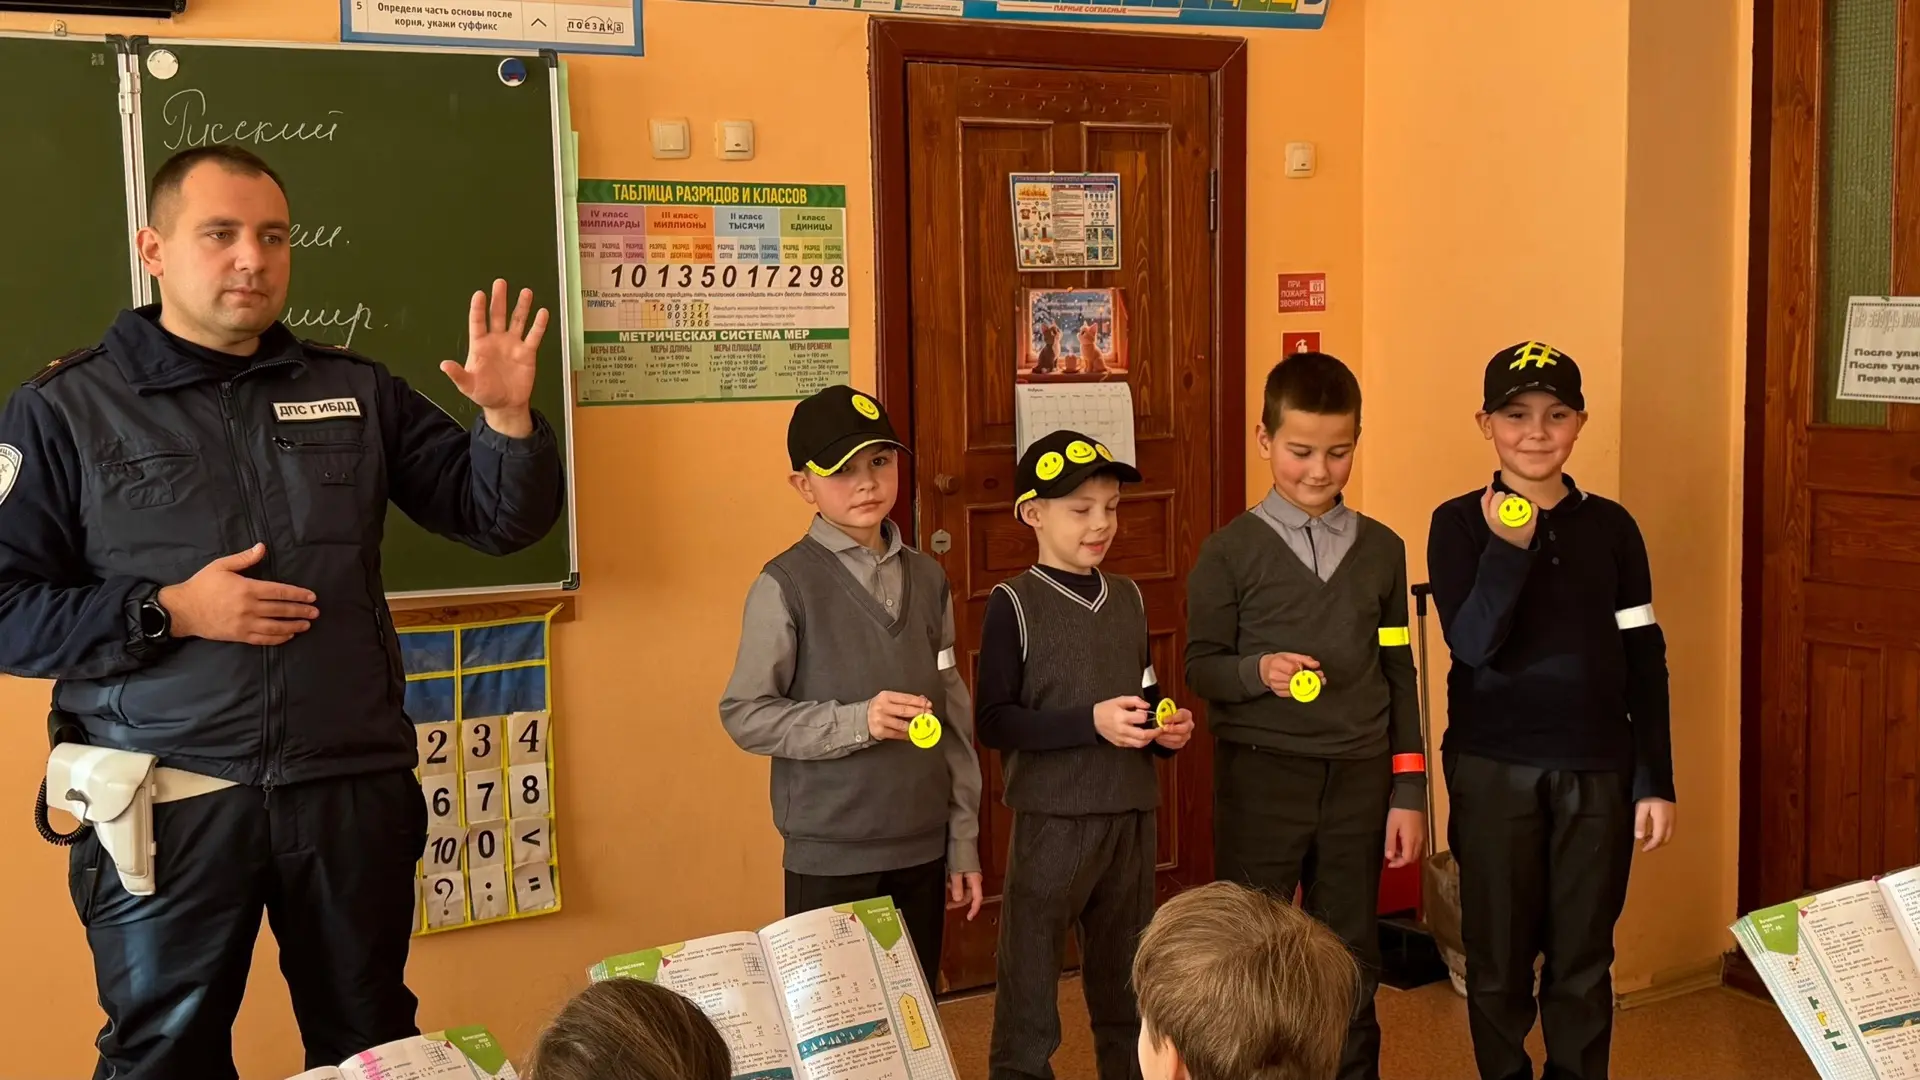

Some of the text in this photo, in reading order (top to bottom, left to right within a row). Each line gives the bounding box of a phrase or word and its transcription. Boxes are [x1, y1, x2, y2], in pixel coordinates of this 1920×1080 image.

[356, 1, 513, 18] 5 Определи часть основы после
[1053, 4, 1084, 12] ПАРНЫЕ
[394, 18, 498, 31] корня, укажи суффикс
[567, 18, 624, 33] поездка
[612, 184, 808, 204] ТАБЛИЦА РАЗРЯДОВ И КЛАССОВ
[590, 210, 600, 218] IV
[580, 220, 640, 229] МИЛЛИАРДЫ
[587, 300, 616, 308] ПРИМЕРЫ:
[619, 330, 810, 341] МЕТРИЧЕСКАЯ СИСТЕМА МЕР
[591, 345, 625, 354] МЕРЫ ВЕСА
[650, 345, 692, 353] МЕРЫ ДЛИНЫ
[714, 344, 730, 352] МЕРЫ
[1854, 348, 1892, 357] После
[1849, 361, 1888, 369] После
[1857, 374, 1896, 384] Перед
[280, 401, 357, 417] ДПС ГИБДД
[426, 720, 539, 764] 2 3 4
[432, 775, 540, 816] 6 7 8
[431, 837, 457, 864] 10
[478, 830, 495, 858] 0
